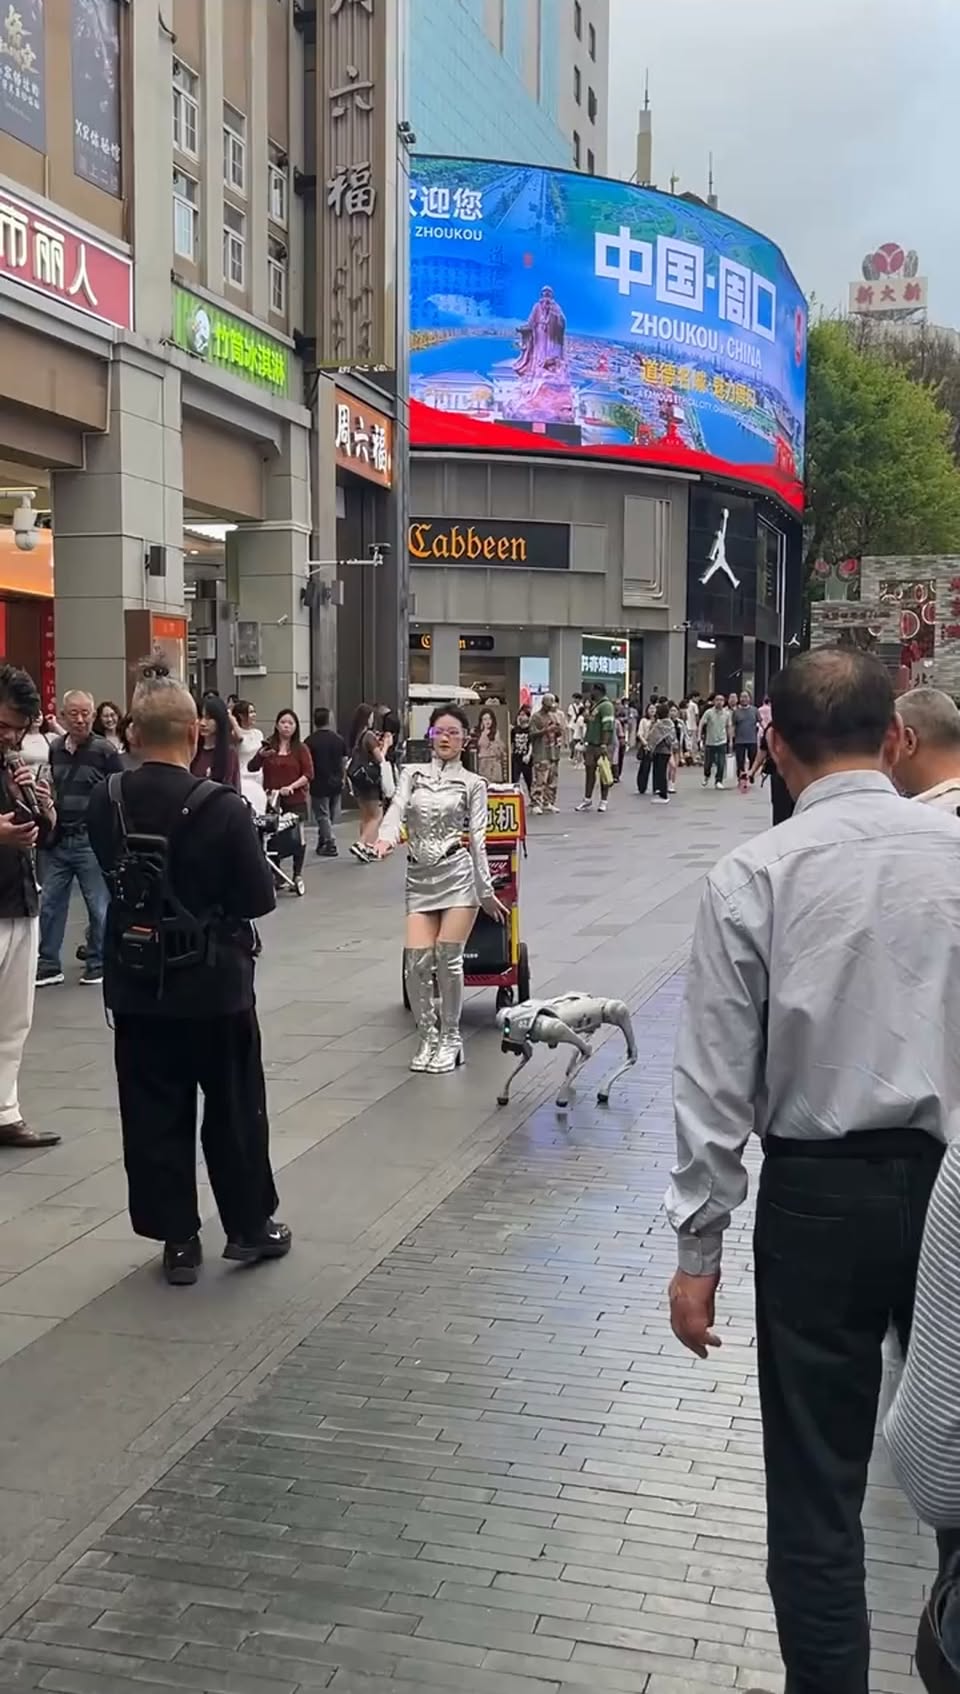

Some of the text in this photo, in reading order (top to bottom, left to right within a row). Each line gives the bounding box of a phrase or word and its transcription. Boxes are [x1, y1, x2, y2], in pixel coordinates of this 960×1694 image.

[328, 0, 376, 216] 六福
[415, 226, 483, 241] ZHOUKOU
[727, 337, 763, 370] CHINA
[335, 403, 388, 475] 周六福
[408, 523, 528, 561] Cabbeen
